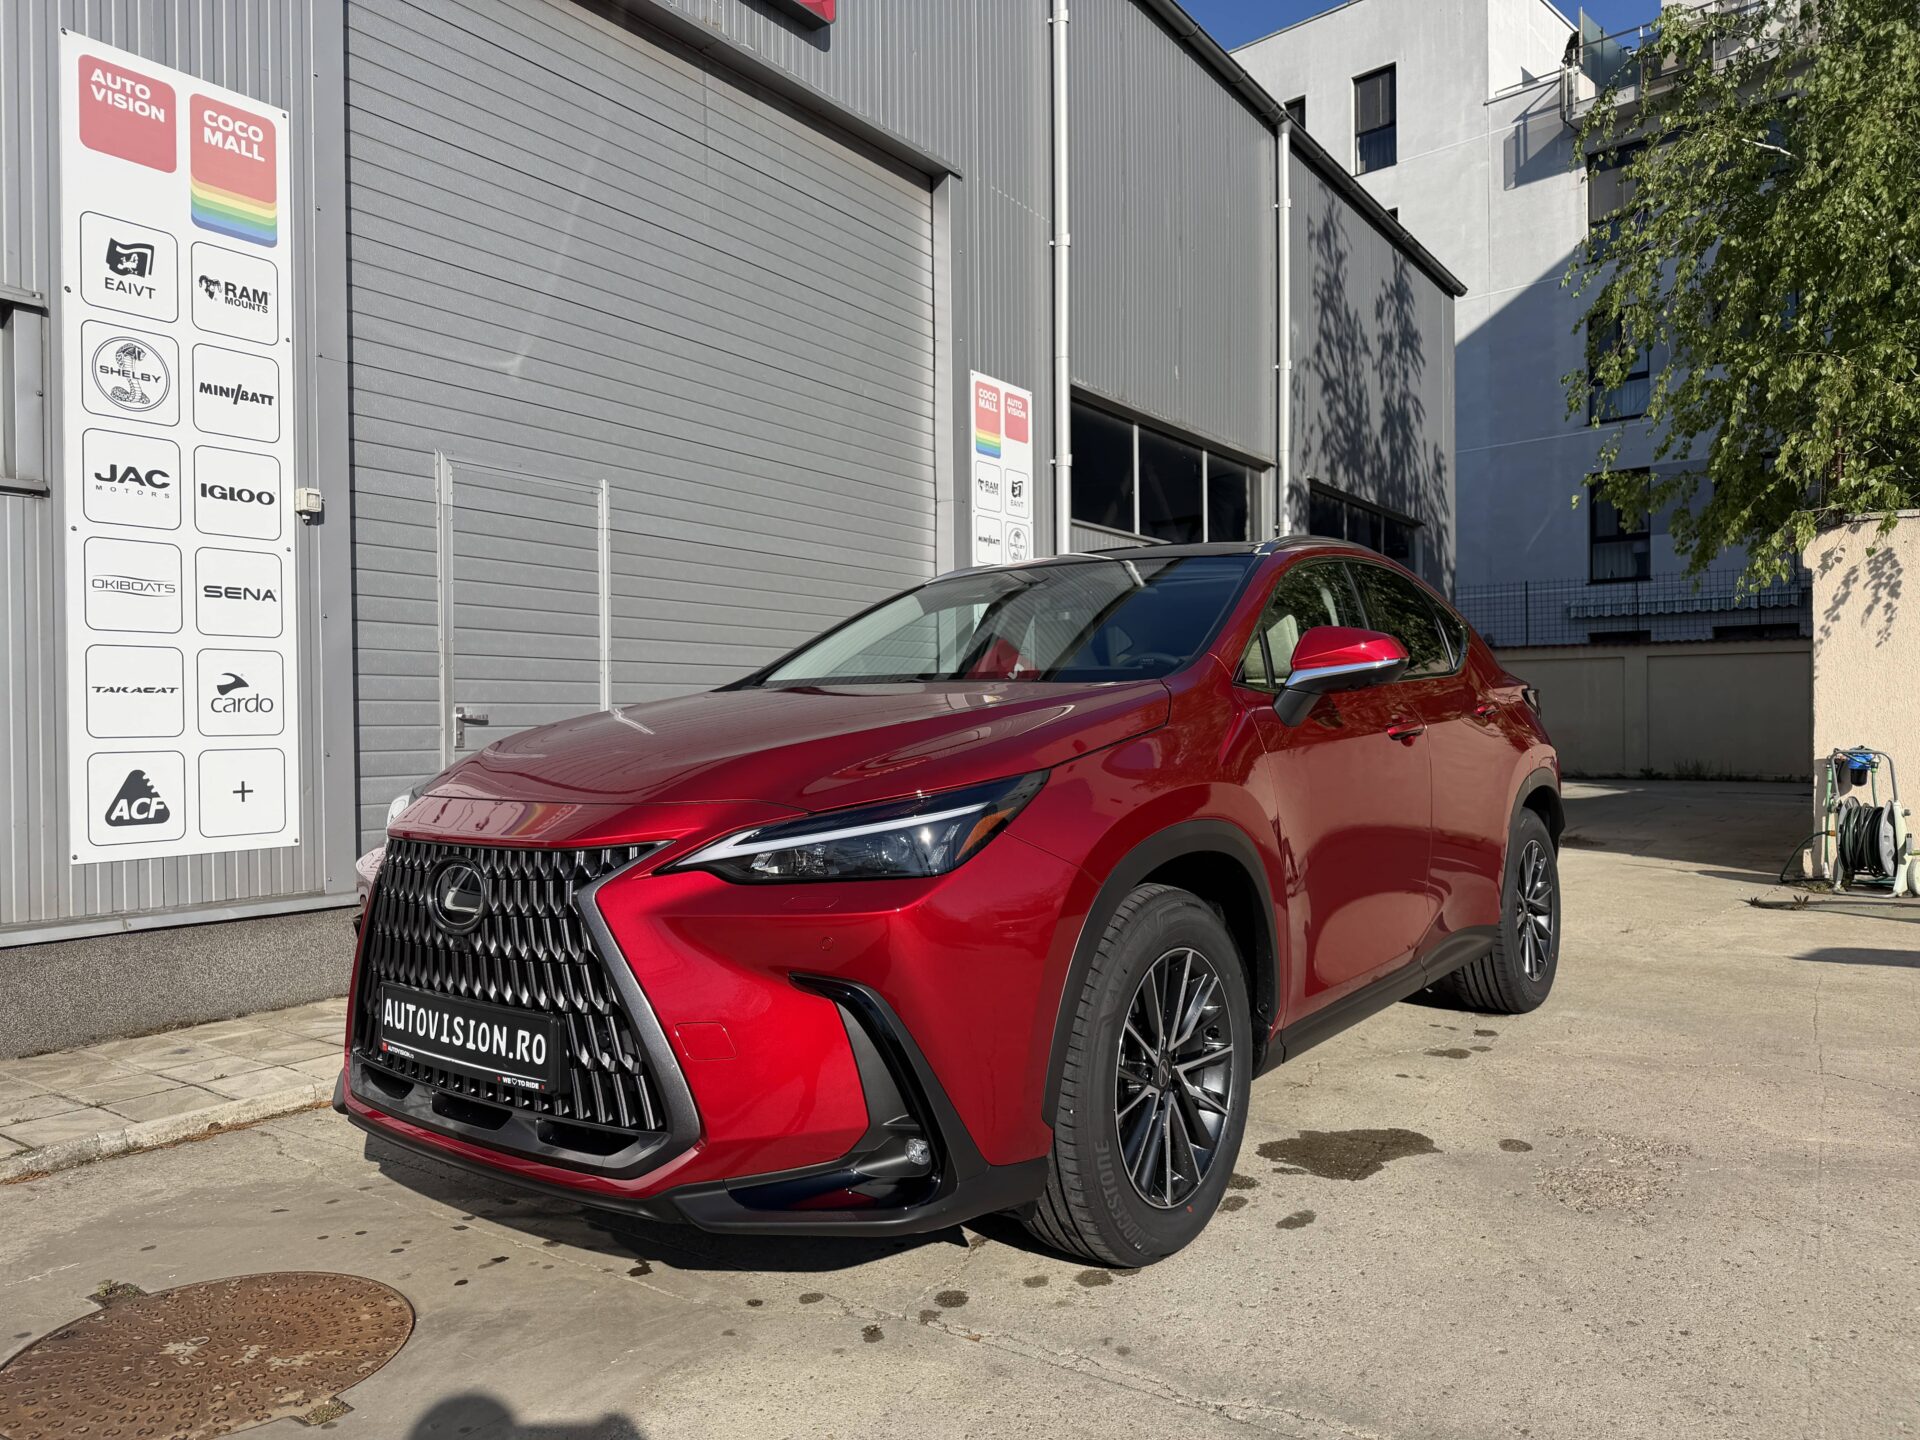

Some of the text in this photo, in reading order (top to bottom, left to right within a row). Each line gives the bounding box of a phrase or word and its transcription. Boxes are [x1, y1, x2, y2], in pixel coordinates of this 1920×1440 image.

[91, 68, 151, 100] AUTO
[90, 84, 165, 123] VISION
[203, 109, 264, 142] COCO
[204, 127, 265, 162] MALL
[104, 276, 156, 300] EAIVT
[224, 281, 268, 306] RAM
[224, 297, 268, 314] MOUNTS
[99, 365, 162, 384] SHELBY
[979, 388, 998, 402] COCO
[1007, 397, 1023, 409] AUTO
[978, 397, 998, 413] MALL
[1007, 406, 1026, 420] VISION
[94, 464, 170, 489] JAC
[985, 480, 999, 490] RAM
[95, 484, 170, 499] MOTORS
[200, 483, 275, 506] IGLOO
[92, 578, 176, 594] OKIBOATS
[203, 584, 277, 602] SENA
[91, 685, 179, 695] TAKACAT
[210, 693, 274, 714] cardo
[110, 797, 165, 822] ACF
[383, 998, 546, 1065] AUTOVISION.RO
[502, 1076, 540, 1090] WE TO RIDE
